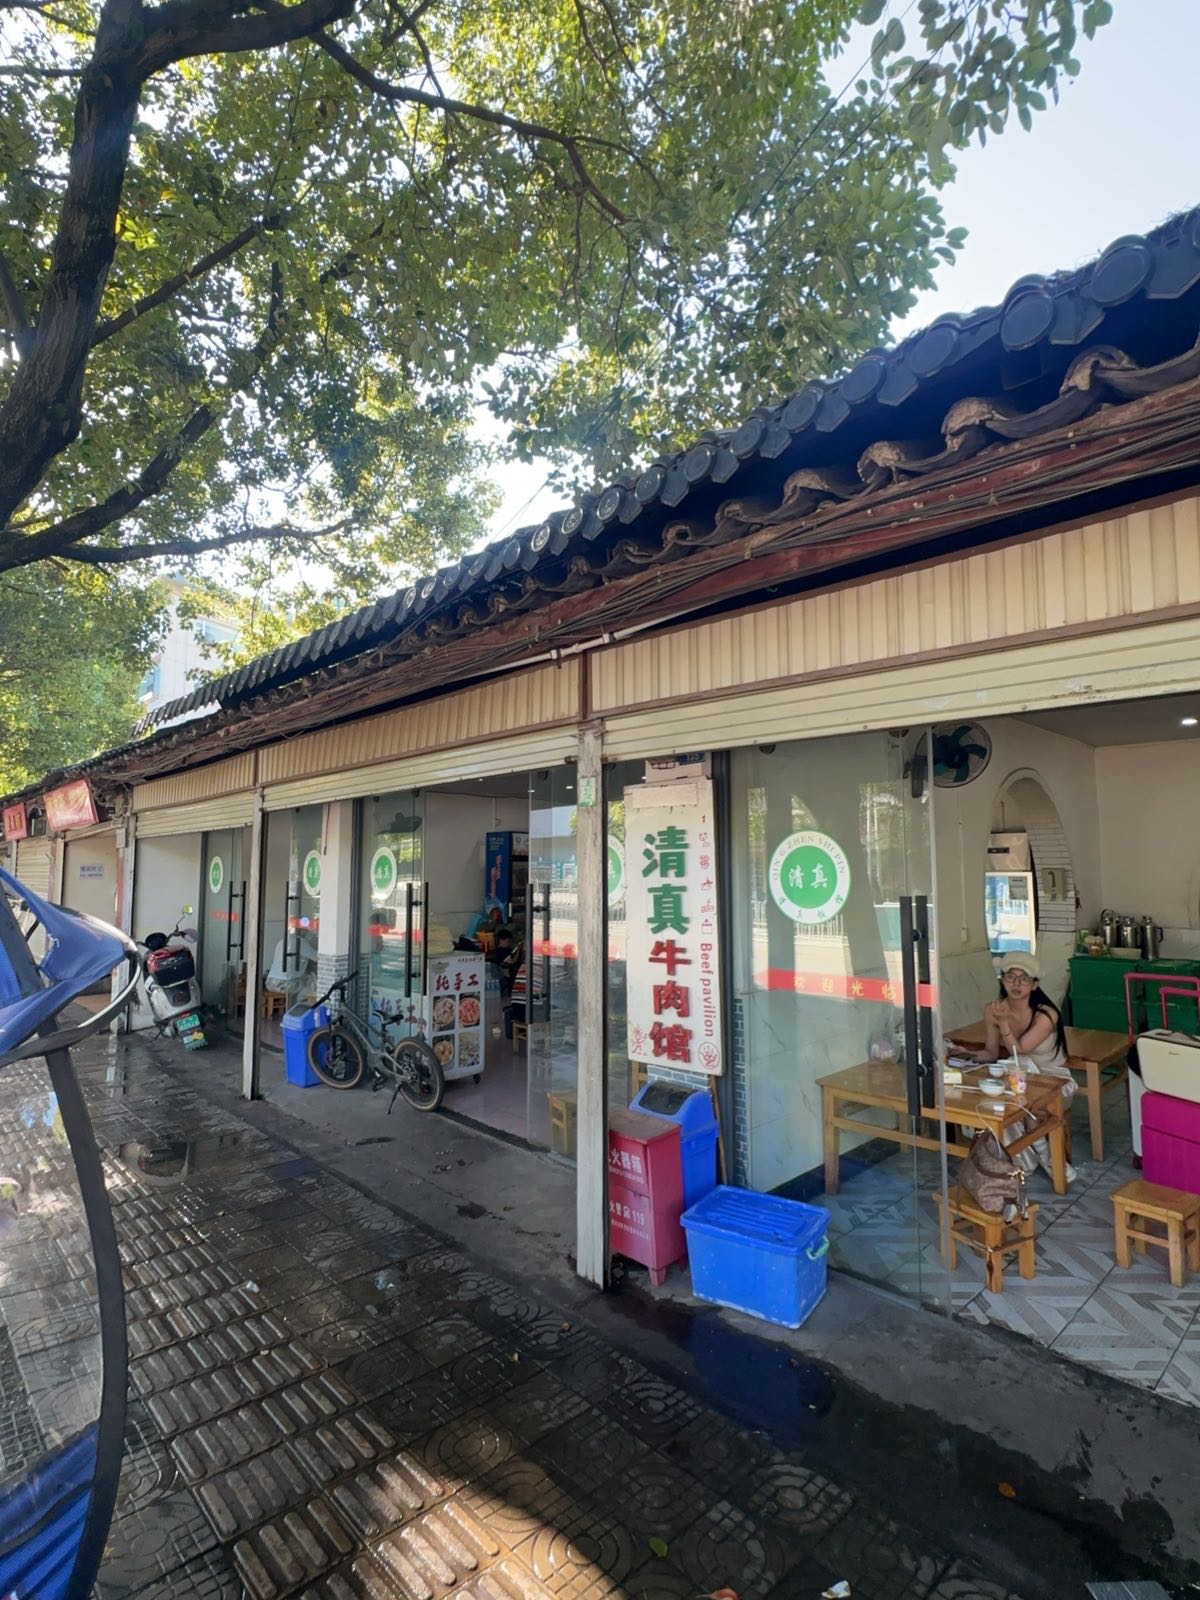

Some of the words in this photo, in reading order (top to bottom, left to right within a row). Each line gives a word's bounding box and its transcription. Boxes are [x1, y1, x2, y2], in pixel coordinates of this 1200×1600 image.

[788, 863, 829, 889] 清真
[641, 825, 693, 1064] 清真牛肉馆
[699, 943, 714, 976] Beef
[435, 972, 480, 992] 纯手工
[793, 975, 897, 1001] 欢迎光临
[699, 978, 716, 1038] pavilion
[608, 1148, 642, 1174] 火器箱
